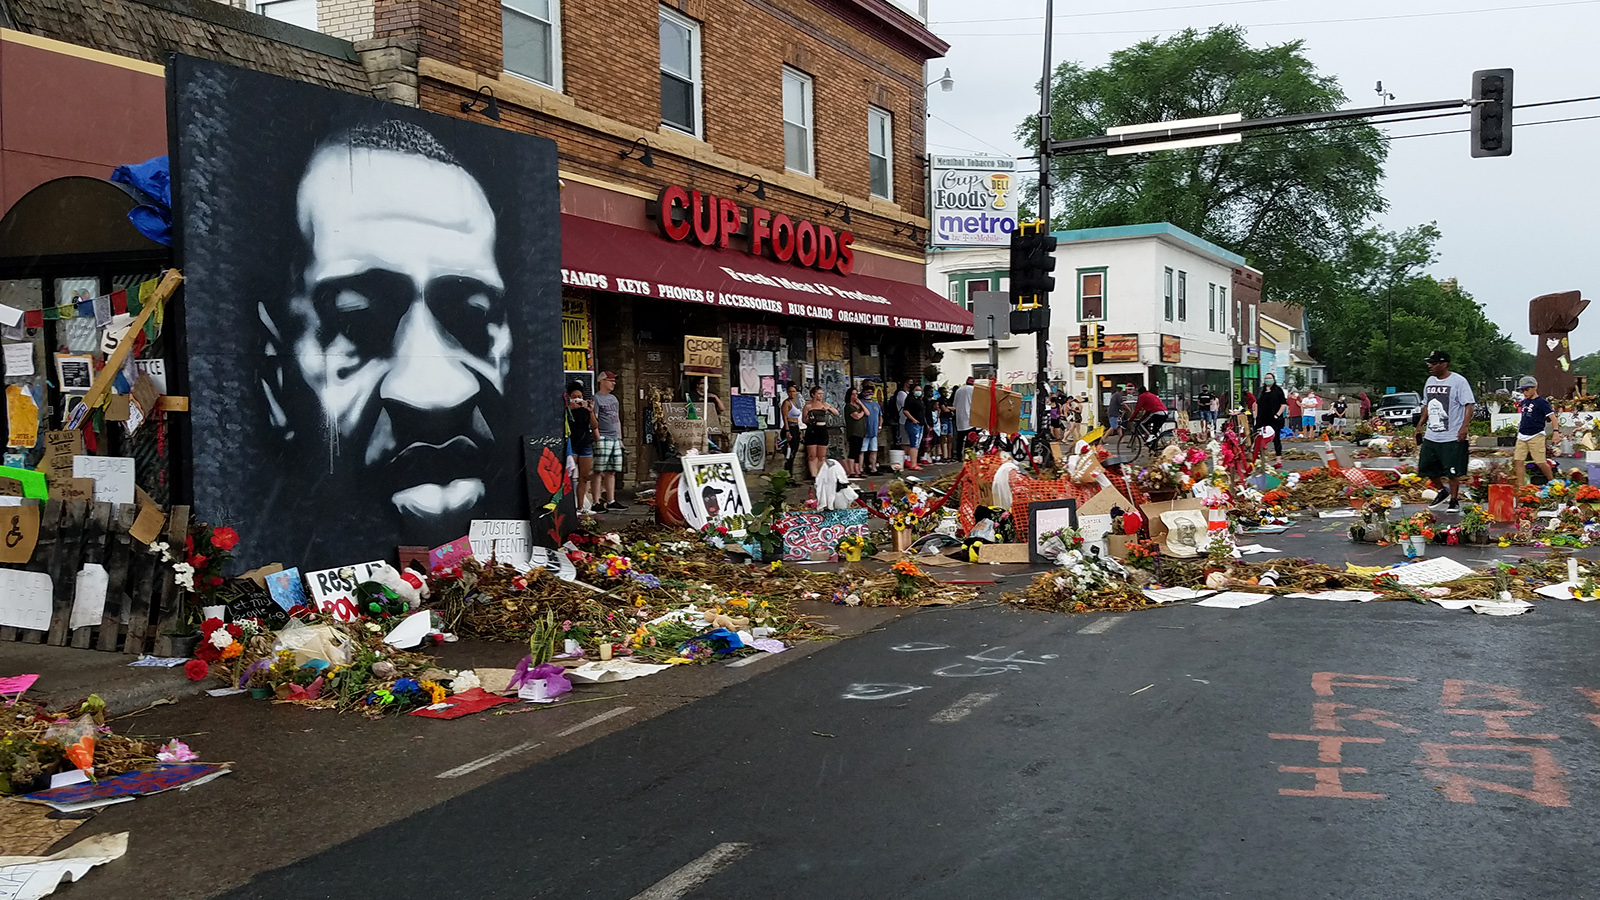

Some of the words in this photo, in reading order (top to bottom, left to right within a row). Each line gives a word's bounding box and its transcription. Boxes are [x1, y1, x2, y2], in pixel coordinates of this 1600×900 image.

[936, 157, 965, 167] Menthol
[967, 158, 995, 168] Tobacco
[997, 159, 1014, 169] Shop
[941, 170, 982, 193] Cup
[991, 179, 1009, 190] DELI
[936, 189, 987, 208] Foods
[660, 184, 741, 248] CUP
[752, 206, 855, 275] FOODS
[938, 212, 1015, 234] metro
[719, 266, 782, 288] Fresh
[771, 276, 821, 295] Meat
[814, 283, 834, 296] &
[828, 285, 892, 305] Produce
[615, 278, 650, 295] KEYS
[657, 284, 703, 303] PHONES
[706, 291, 714, 303] &
[718, 292, 783, 313] ACCESSORIES
[788, 303, 806, 316] BUS
[806, 305, 833, 320] CARDS
[838, 309, 871, 325] ORGANIC
[872, 315, 890, 326] MILK
[893, 316, 922, 330] T-SHIRTS
[924, 320, 950, 332] MEXICAN
[950, 323, 964, 334] FOOD
[84, 457, 129, 474] PLEASE
[481, 520, 522, 536] JUSTICE
[470, 537, 530, 555] JUNETEENTH
